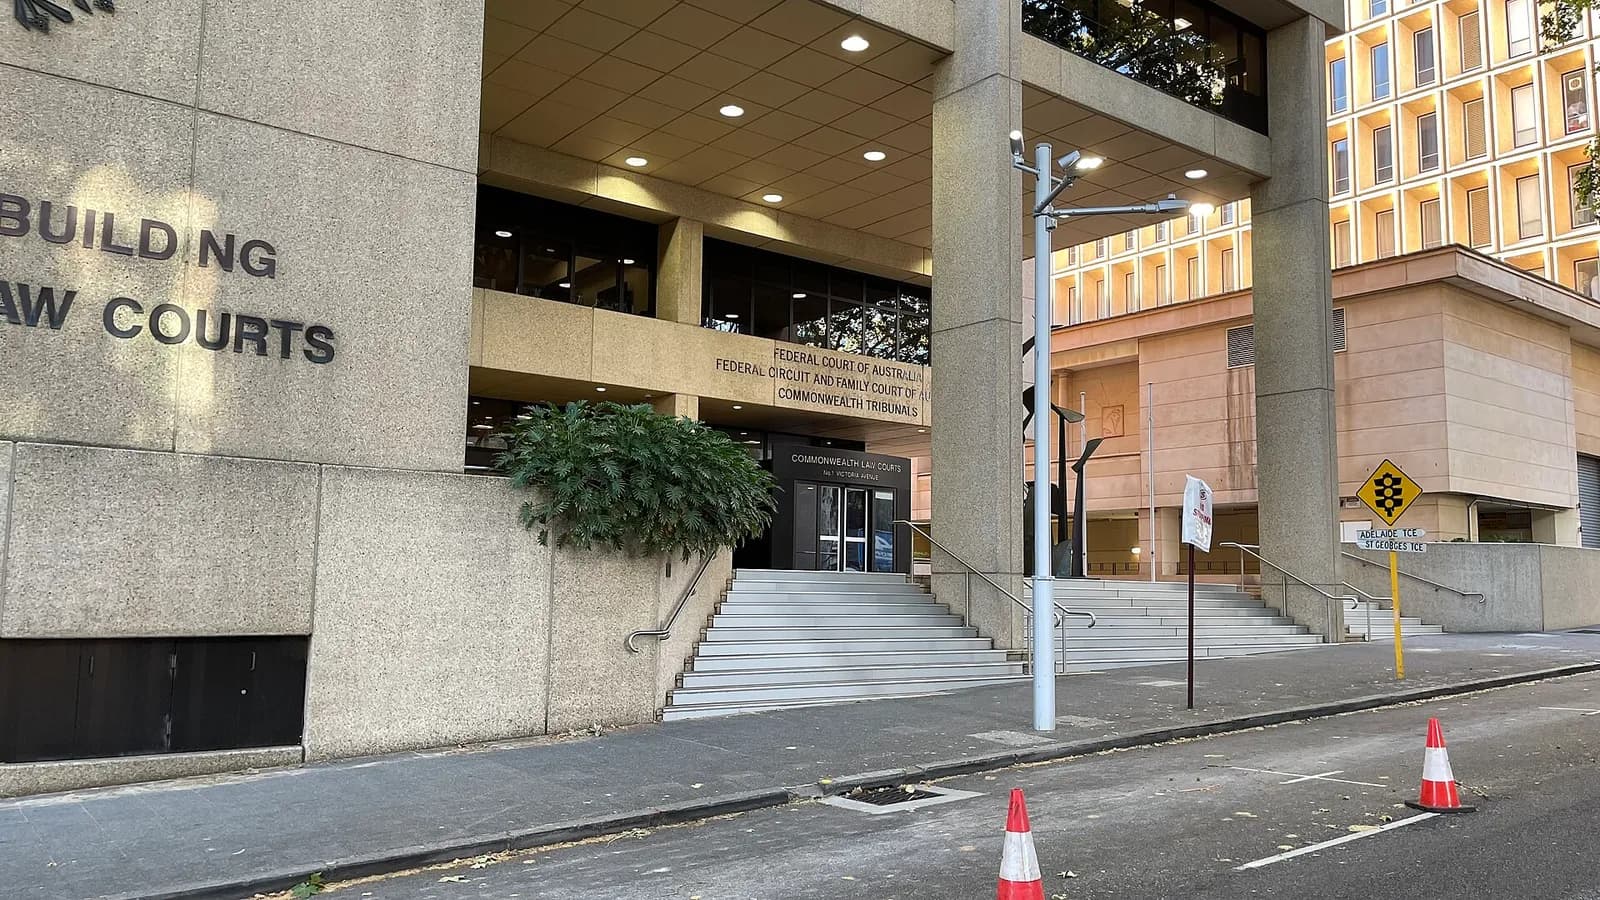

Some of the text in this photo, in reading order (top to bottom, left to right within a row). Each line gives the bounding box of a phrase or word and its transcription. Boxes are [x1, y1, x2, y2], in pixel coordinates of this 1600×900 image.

[0, 193, 277, 279] BUILDNG
[103, 297, 336, 365] COURTS
[774, 348, 820, 366] FEDERAL
[822, 357, 855, 371] COURT
[857, 362, 870, 373] OF
[716, 358, 766, 377] FEDERAL
[768, 366, 811, 383] CIRCUIT
[813, 374, 835, 387] AND
[836, 377, 870, 393] FAMILY
[871, 382, 904, 397] COURT
[905, 388, 917, 399] OF
[778, 387, 919, 417] COMMONWEALTH TRIBUNALS
[791, 454, 902, 474] COMMONWEALTH LAW COURTS
[836, 470, 860, 479] VICTORIA
[860, 472, 880, 481] AVENUE
[1360, 529, 1418, 539] ADELAIDE TCE
[1365, 540, 1424, 552] ST GEORGES TCE
